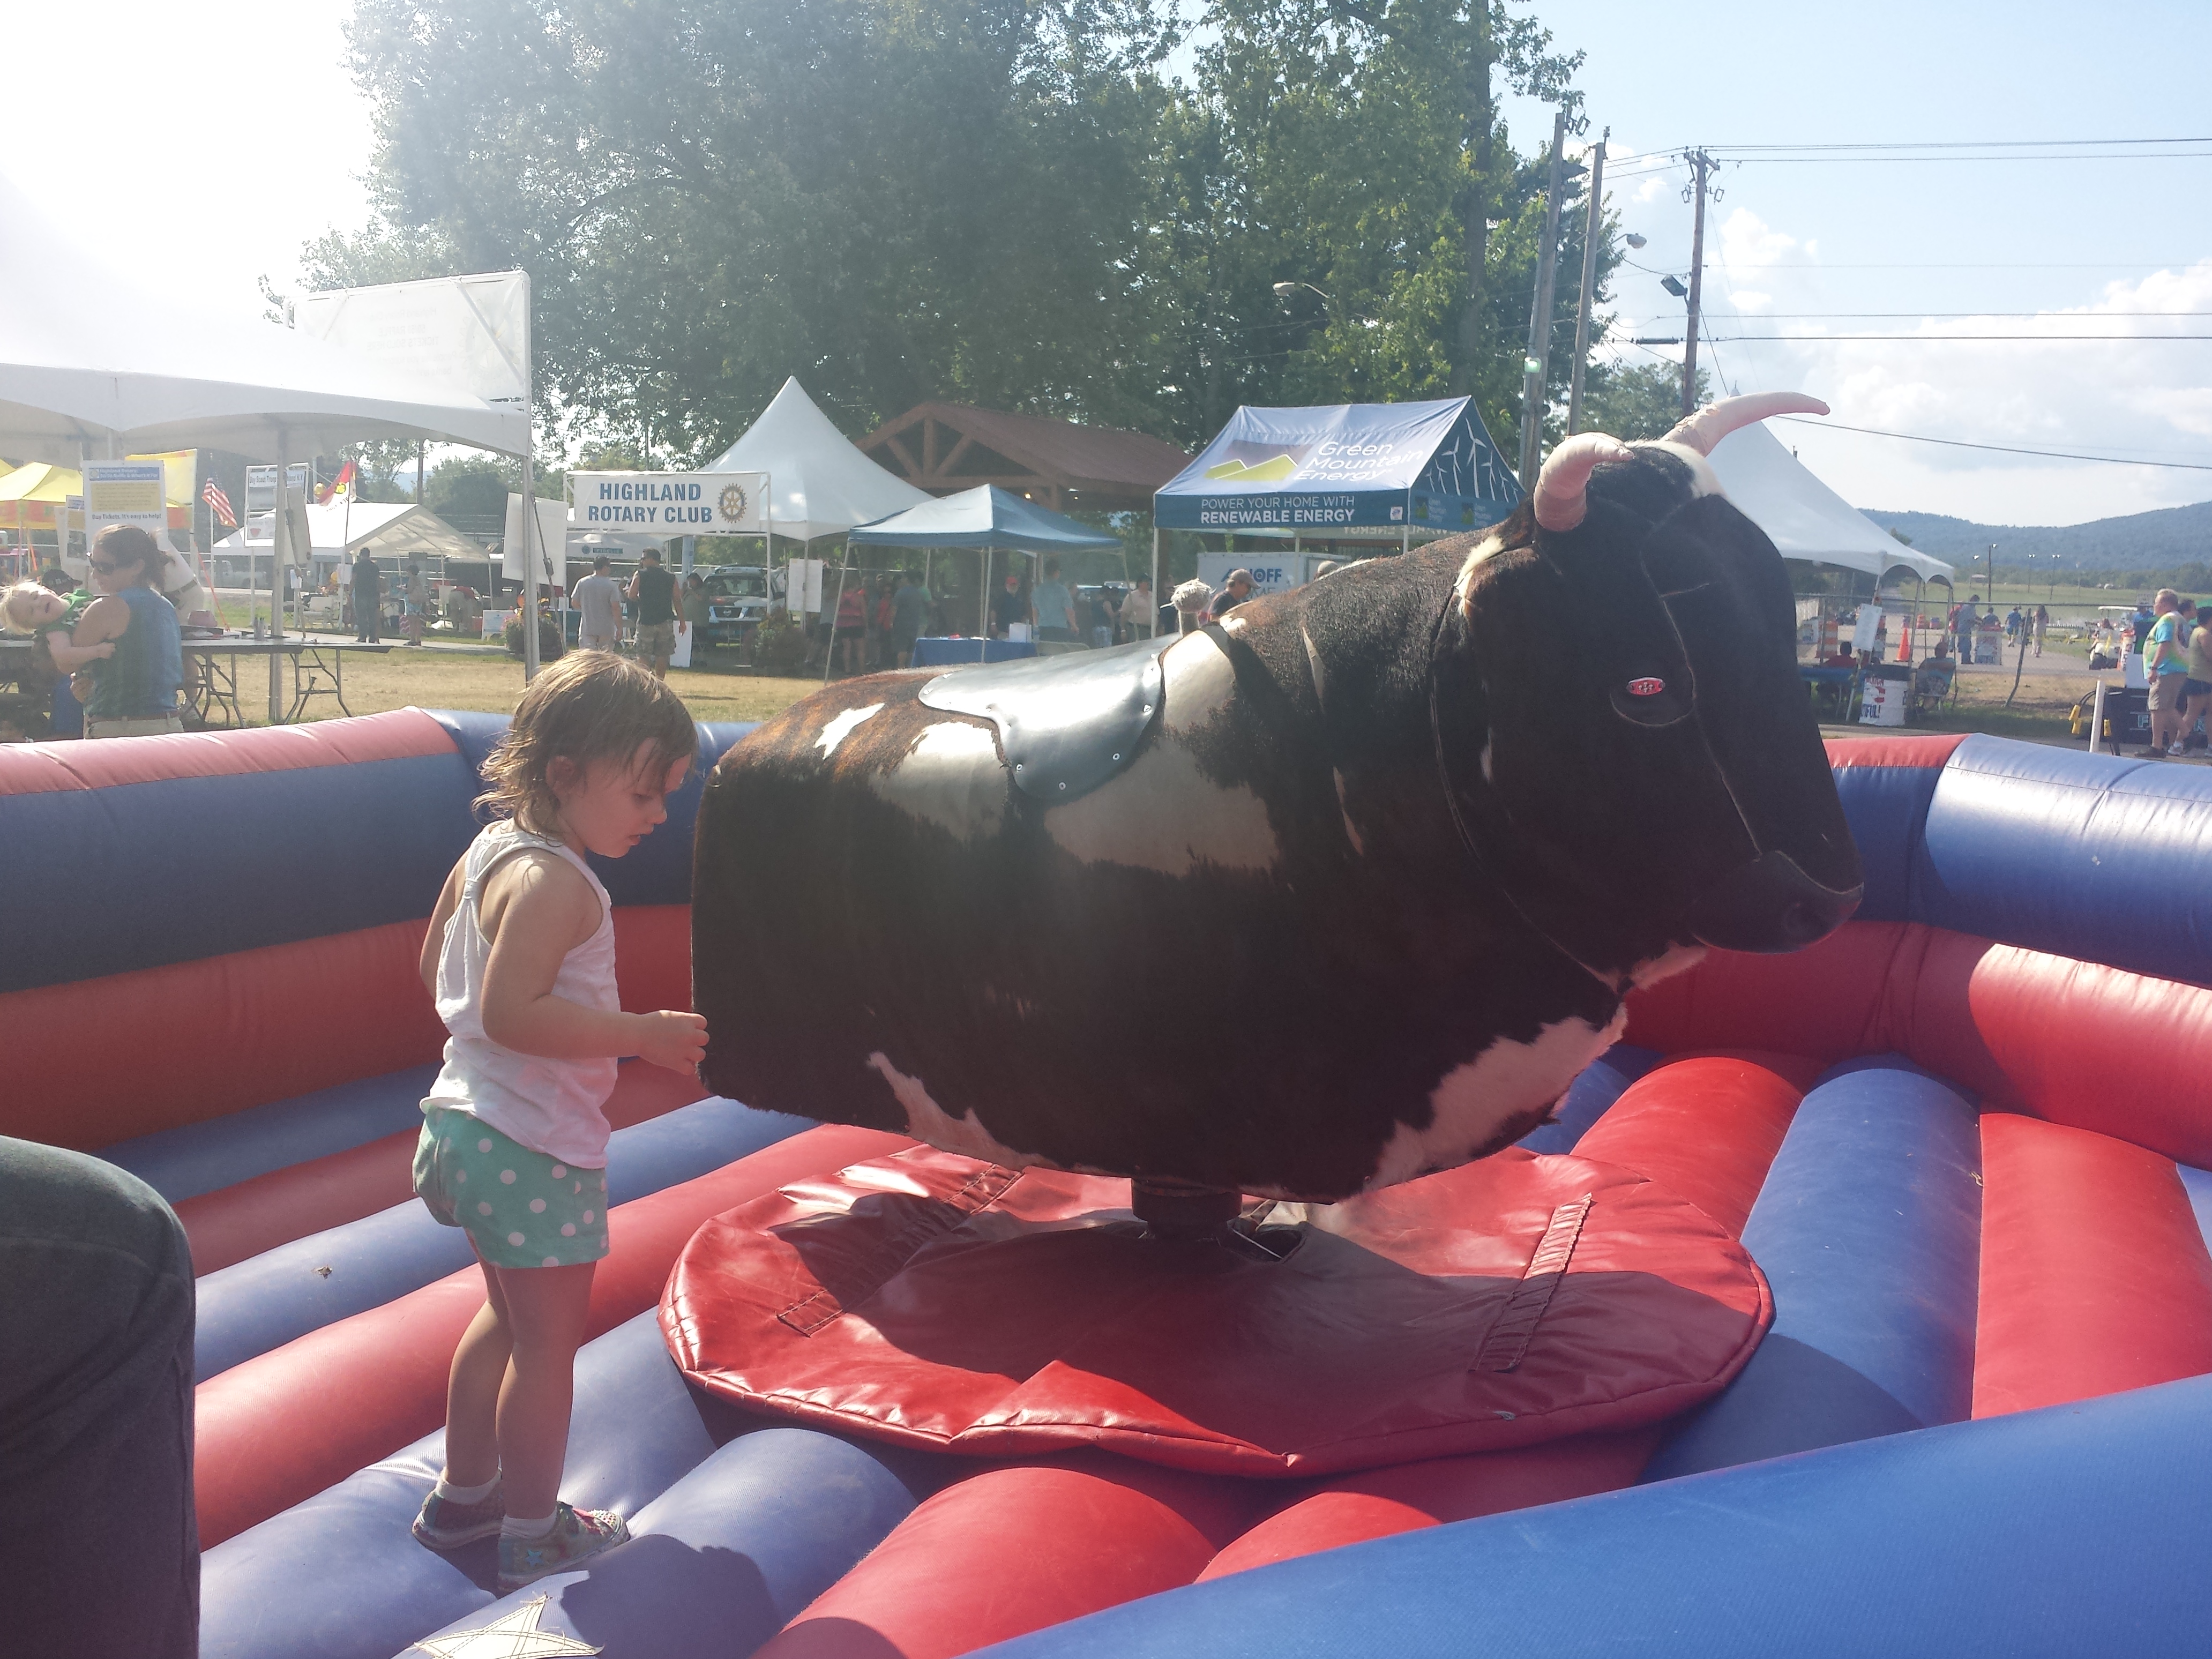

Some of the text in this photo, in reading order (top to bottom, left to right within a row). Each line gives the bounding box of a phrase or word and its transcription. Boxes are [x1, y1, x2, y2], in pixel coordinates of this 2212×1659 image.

[1318, 441, 1394, 456] Green
[1305, 450, 1424, 470] Mountain
[1293, 469, 1386, 482] Energy
[599, 482, 701, 501] HIGHLAND
[1201, 495, 1355, 510] POWER YOUR HOME WITH
[588, 505, 713, 523] ROTARY CLUB
[1200, 508, 1355, 524] RENEWABLE ENERGY
